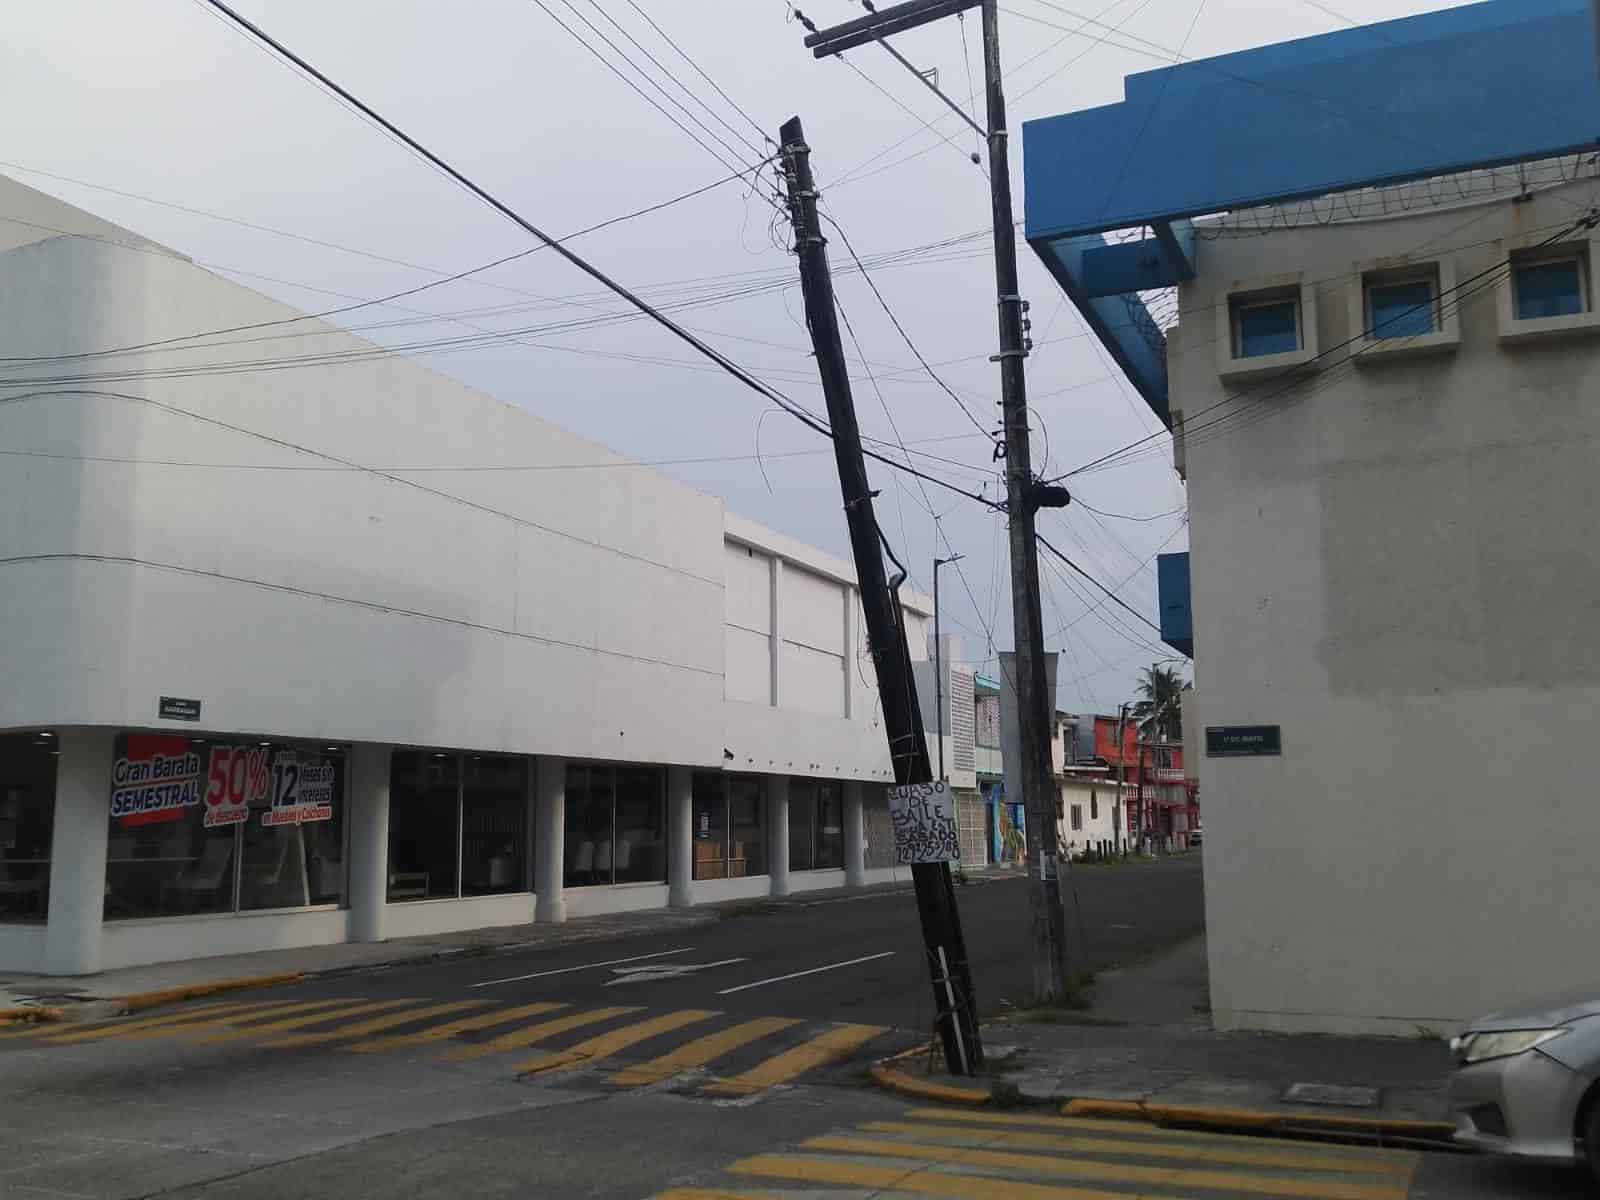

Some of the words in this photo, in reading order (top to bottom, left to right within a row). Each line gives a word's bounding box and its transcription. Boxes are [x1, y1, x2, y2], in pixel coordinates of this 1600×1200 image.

[115, 759, 151, 783] Gran
[152, 752, 199, 778] Barata
[208, 748, 267, 806] 50%
[112, 781, 200, 814] SEMESTRAL
[273, 765, 299, 806] 12
[888, 781, 945, 800] CURSO
[891, 805, 945, 826] BAILE
[909, 796, 929, 808] DE
